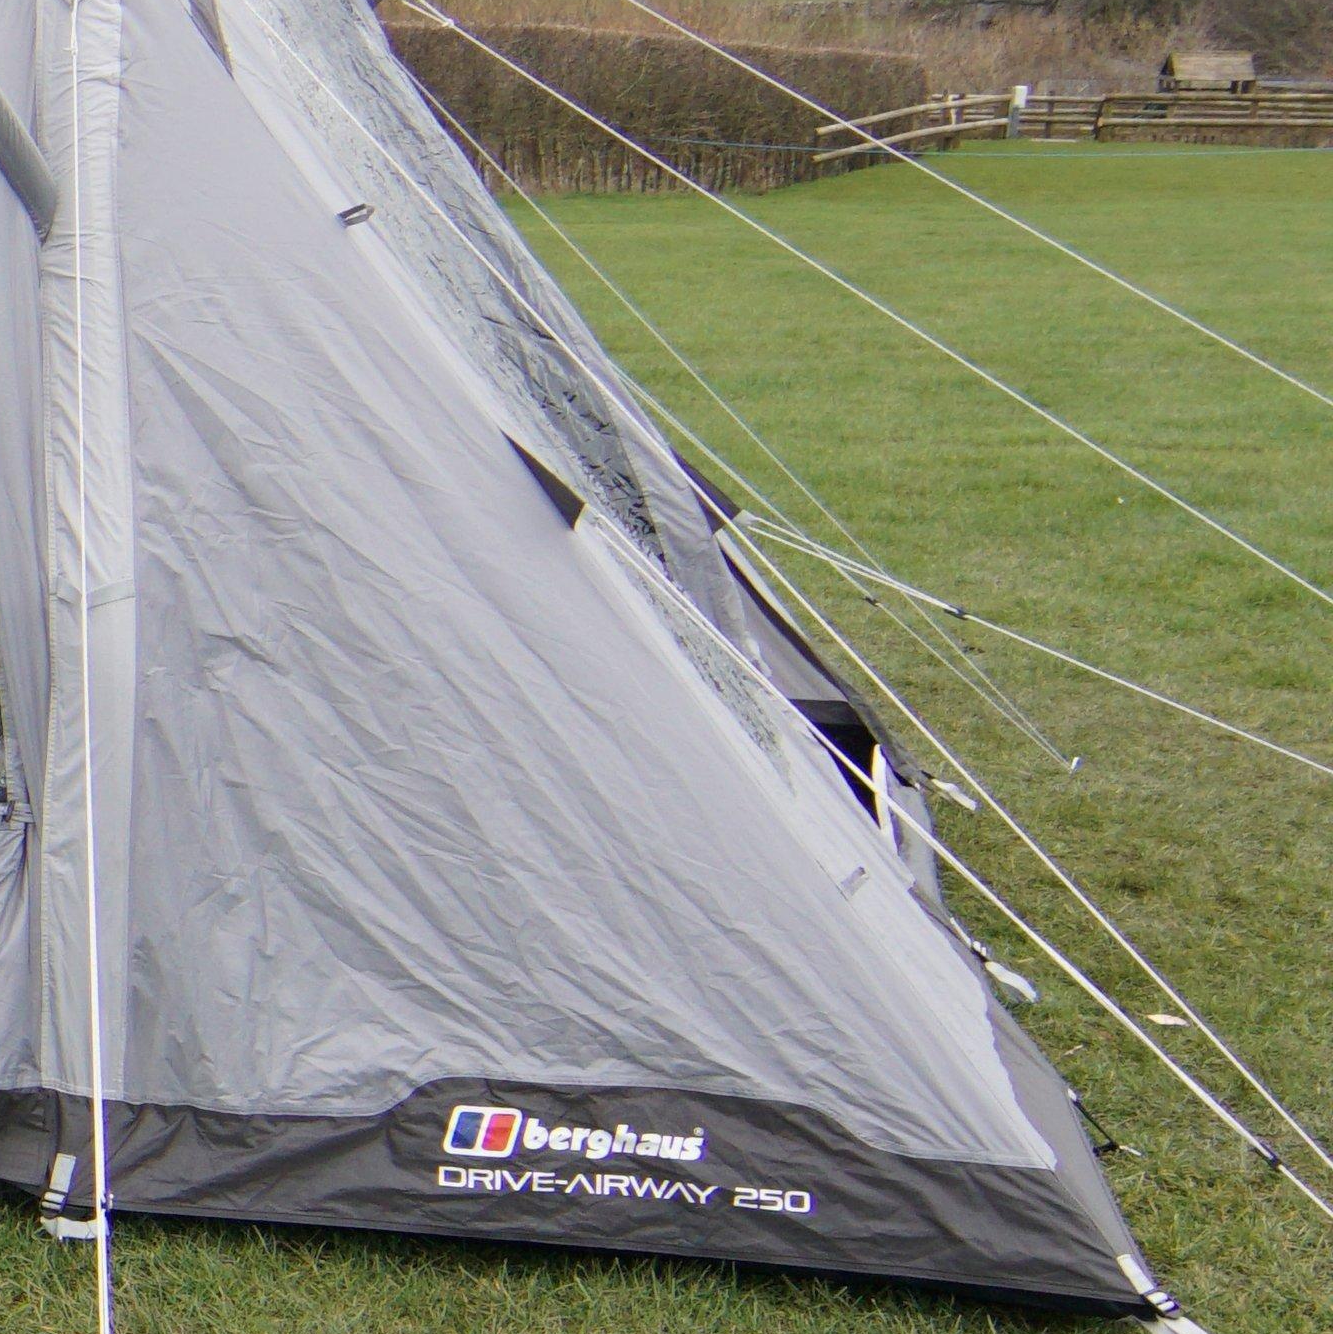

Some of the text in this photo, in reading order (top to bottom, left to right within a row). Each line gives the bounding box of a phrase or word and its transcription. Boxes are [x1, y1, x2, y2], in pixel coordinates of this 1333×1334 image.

[523, 1117, 704, 1160] berghaus
[438, 1166, 812, 1214] DRIVE-AIRWAY 250
